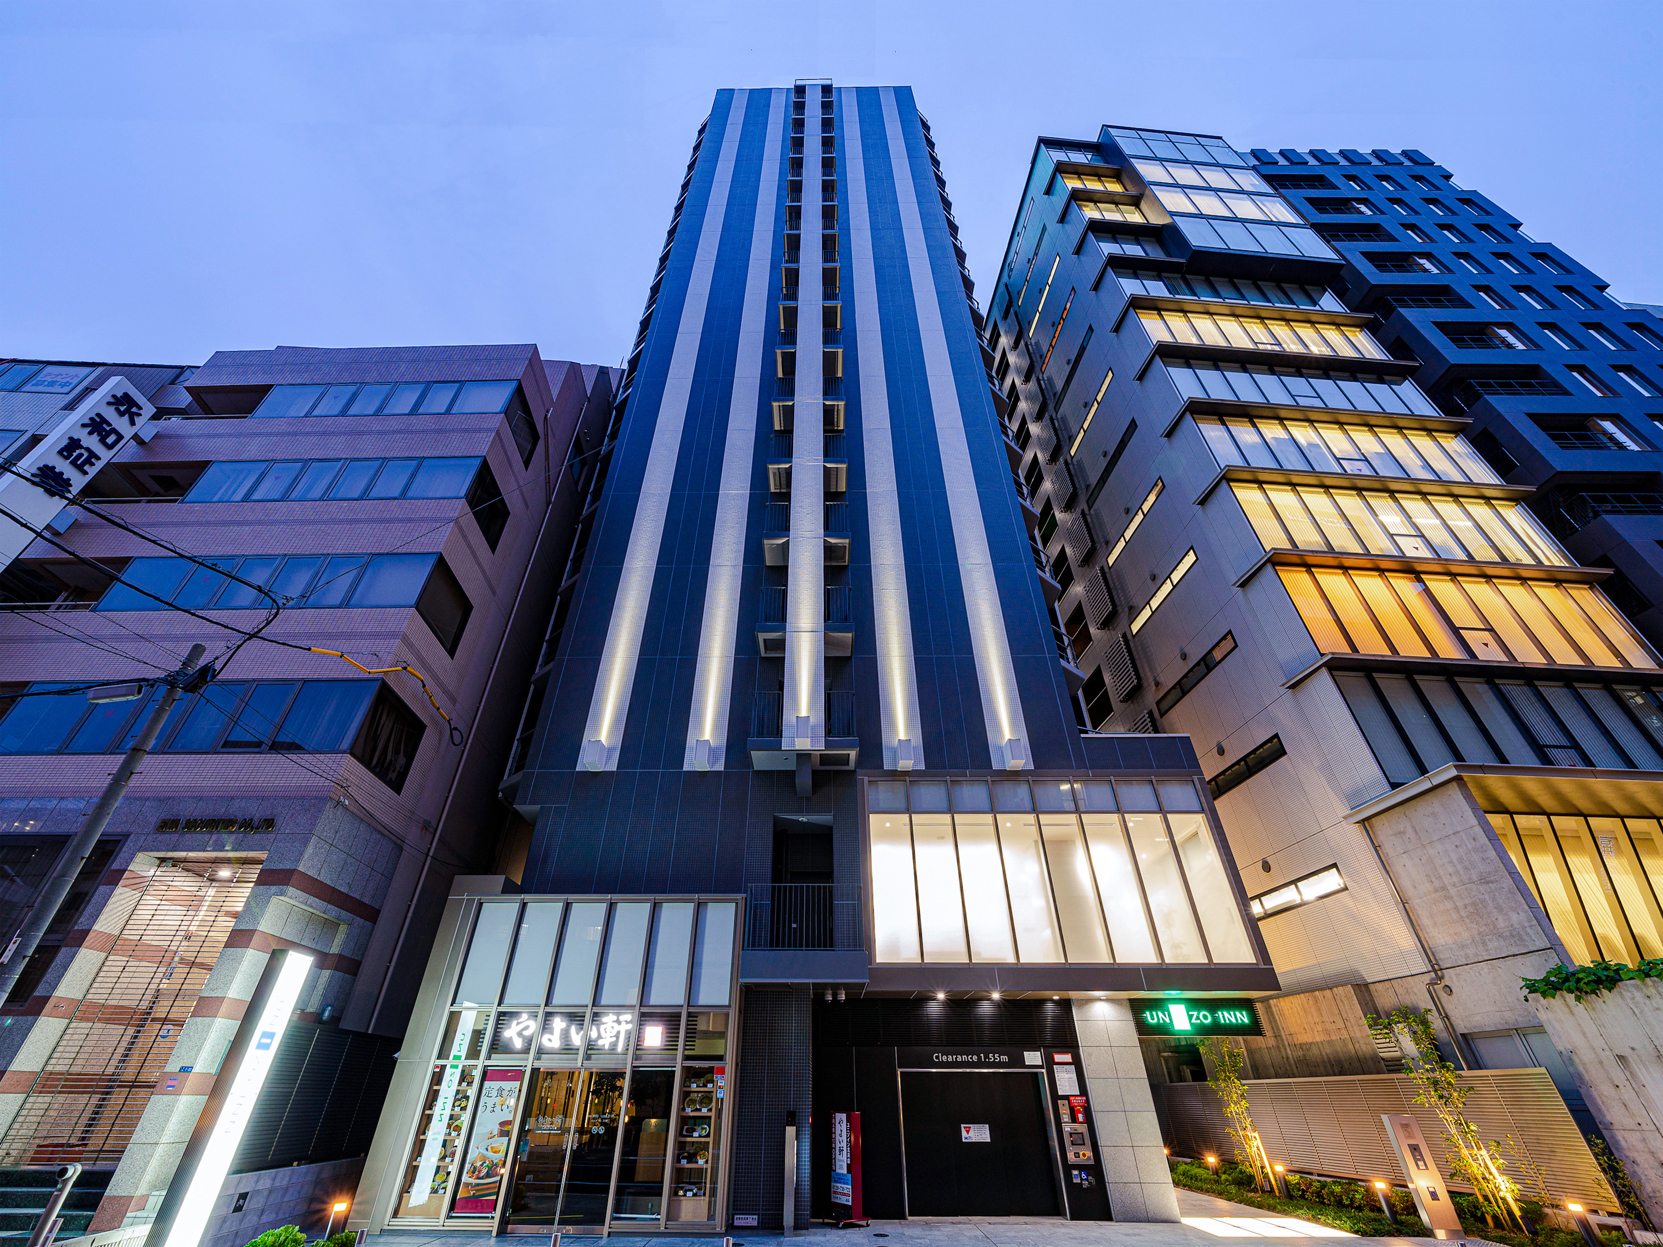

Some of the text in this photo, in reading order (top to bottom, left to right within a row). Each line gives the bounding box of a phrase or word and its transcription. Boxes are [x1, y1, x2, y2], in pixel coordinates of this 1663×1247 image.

[40, 372, 80, 381] テナント
[1217, 1011, 1249, 1023] INN
[503, 1013, 633, 1053] やよい軒
[933, 1053, 1009, 1062] Clearance 1.55m
[483, 1086, 517, 1098] 定食が
[482, 1101, 512, 1114] うまい。
